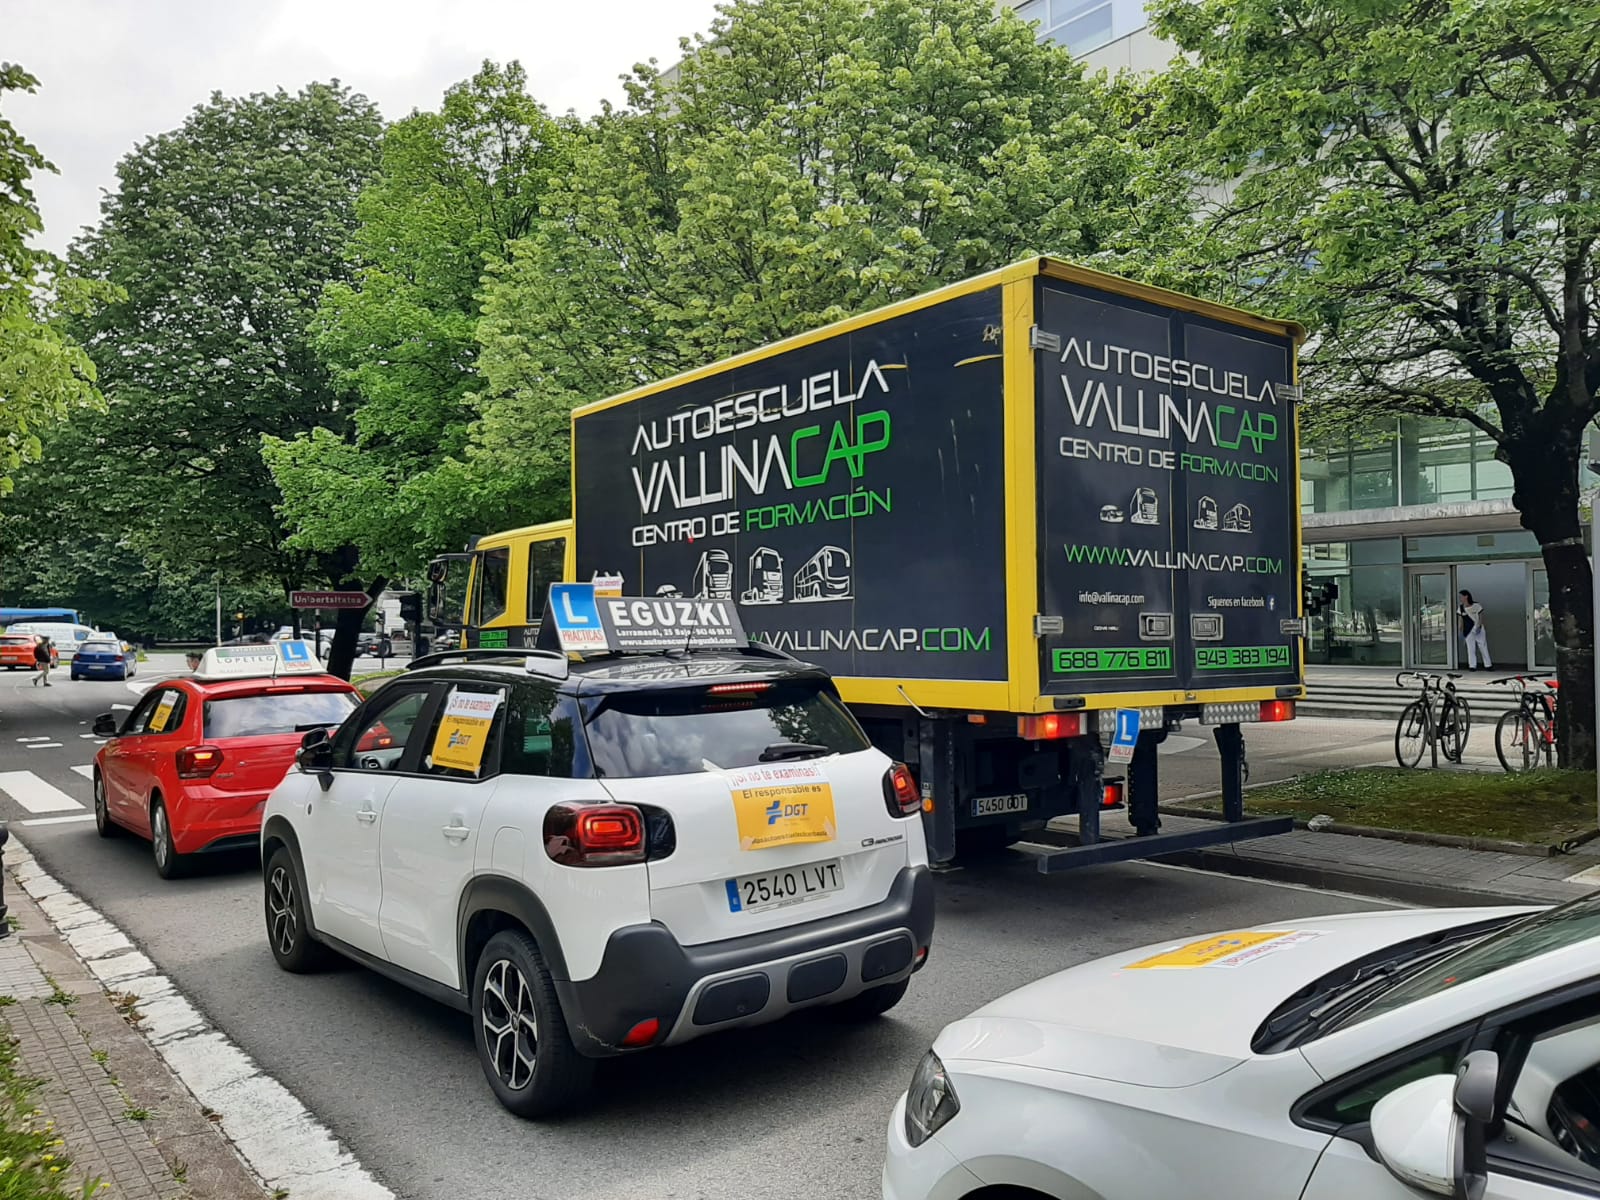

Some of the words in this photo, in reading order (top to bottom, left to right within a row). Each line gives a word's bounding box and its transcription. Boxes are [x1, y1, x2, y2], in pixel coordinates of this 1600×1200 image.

[1060, 337, 1276, 405] AUTOESCUELA
[632, 359, 889, 455] AUTOESCUELA
[1059, 436, 1142, 465] CENTRO
[1148, 449, 1176, 470] DE
[632, 517, 706, 547] CENTRO
[712, 511, 740, 536] DE
[745, 486, 891, 531] FORMACIÓN
[1064, 543, 1282, 575] WWW.VALLINACAP.COM
[562, 592, 589, 624] L
[608, 600, 731, 627] EGUZKI
[1059, 651, 1098, 669] 688
[1103, 650, 1140, 668] 776
[1146, 649, 1168, 667] 811
[1197, 650, 1228, 666] 943
[1231, 648, 1260, 665] 383
[1264, 647, 1287, 664] 194
[742, 789, 753, 799] El
[755, 785, 810, 797] responsable
[811, 785, 822, 793] es
[978, 798, 1004, 813] 5450
[784, 803, 808, 817] DGT
[743, 873, 797, 905] 2540
[803, 864, 837, 893] LVT
